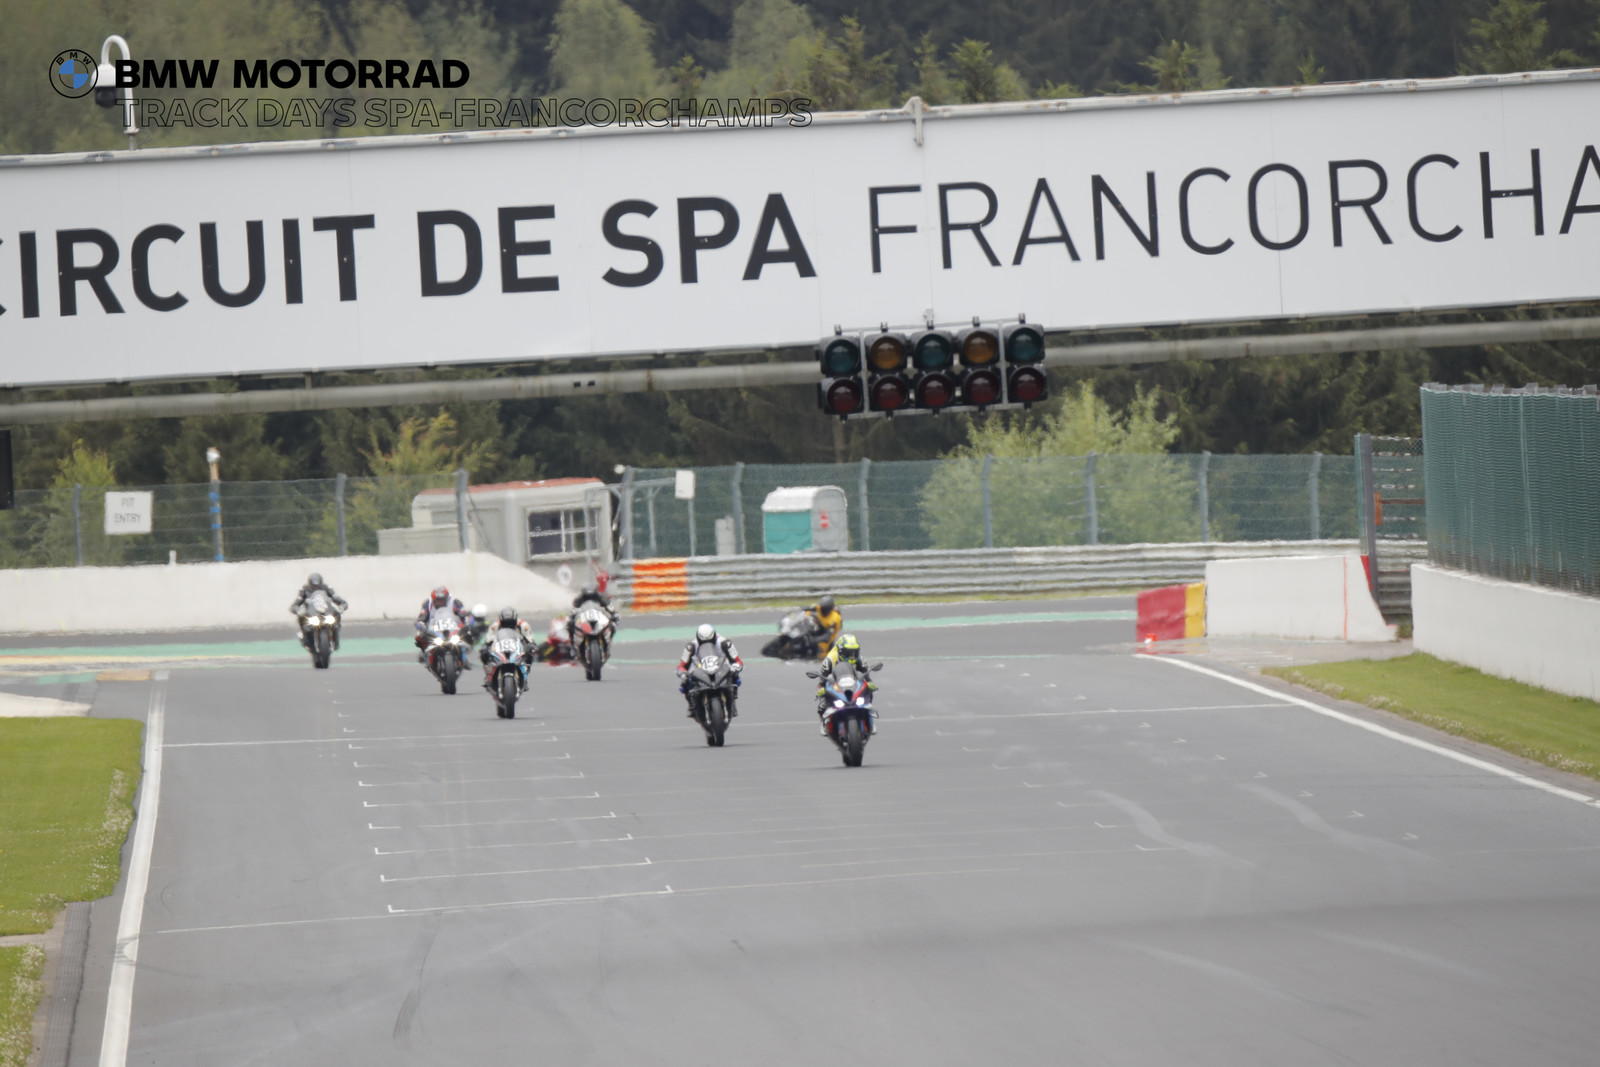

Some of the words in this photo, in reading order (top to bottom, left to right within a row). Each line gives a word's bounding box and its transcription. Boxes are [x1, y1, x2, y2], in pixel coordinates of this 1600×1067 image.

[0, 213, 375, 319] IRCUIT
[417, 204, 560, 298] DE
[601, 192, 817, 288] SPA
[867, 145, 1600, 273] FRANCORCHA
[113, 512, 142, 523] ENTRY
